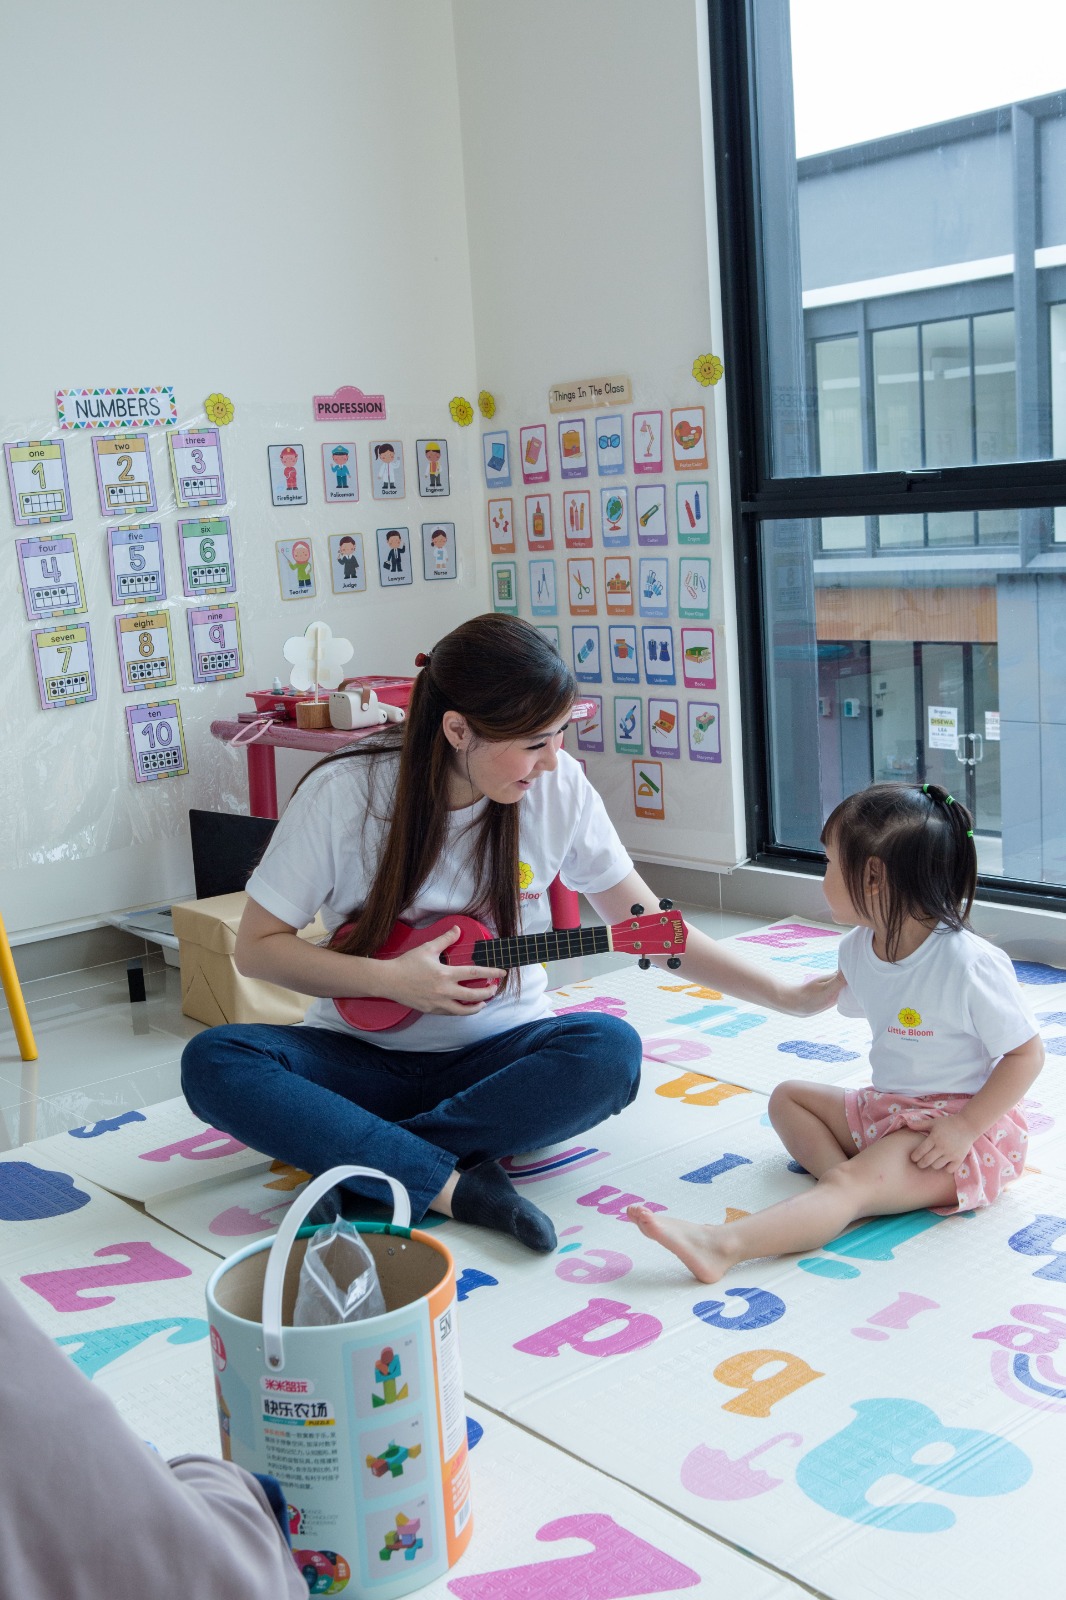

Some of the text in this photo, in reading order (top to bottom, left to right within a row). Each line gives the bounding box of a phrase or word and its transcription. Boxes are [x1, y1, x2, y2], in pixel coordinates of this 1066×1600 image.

[554, 383, 625, 402] Things In The Class
[75, 397, 161, 419] NUMBERS
[317, 402, 383, 414] PROFESSION
[114, 443, 130, 451] two
[185, 436, 206, 445] three
[28, 450, 45, 458] one
[190, 449, 207, 474] 3
[31, 462, 47, 489] 1
[116, 455, 135, 482] 2
[128, 532, 144, 541] five
[38, 543, 57, 553] four
[128, 544, 146, 571] 5
[199, 538, 216, 563] 6
[40, 556, 62, 583] 4
[133, 618, 154, 629] eight
[207, 612, 223, 621] nine
[50, 633, 76, 643] seven
[138, 632, 155, 657] 8
[208, 624, 226, 648] 9
[57, 646, 72, 673] 7
[148, 710, 162, 718] ten
[141, 721, 173, 748] 10
[520, 892, 543, 901] Bloo
[671, 919, 684, 944] MAHALO
[887, 1026, 934, 1037] Little Bloom
[264, 1399, 328, 1418] 快乐农场
